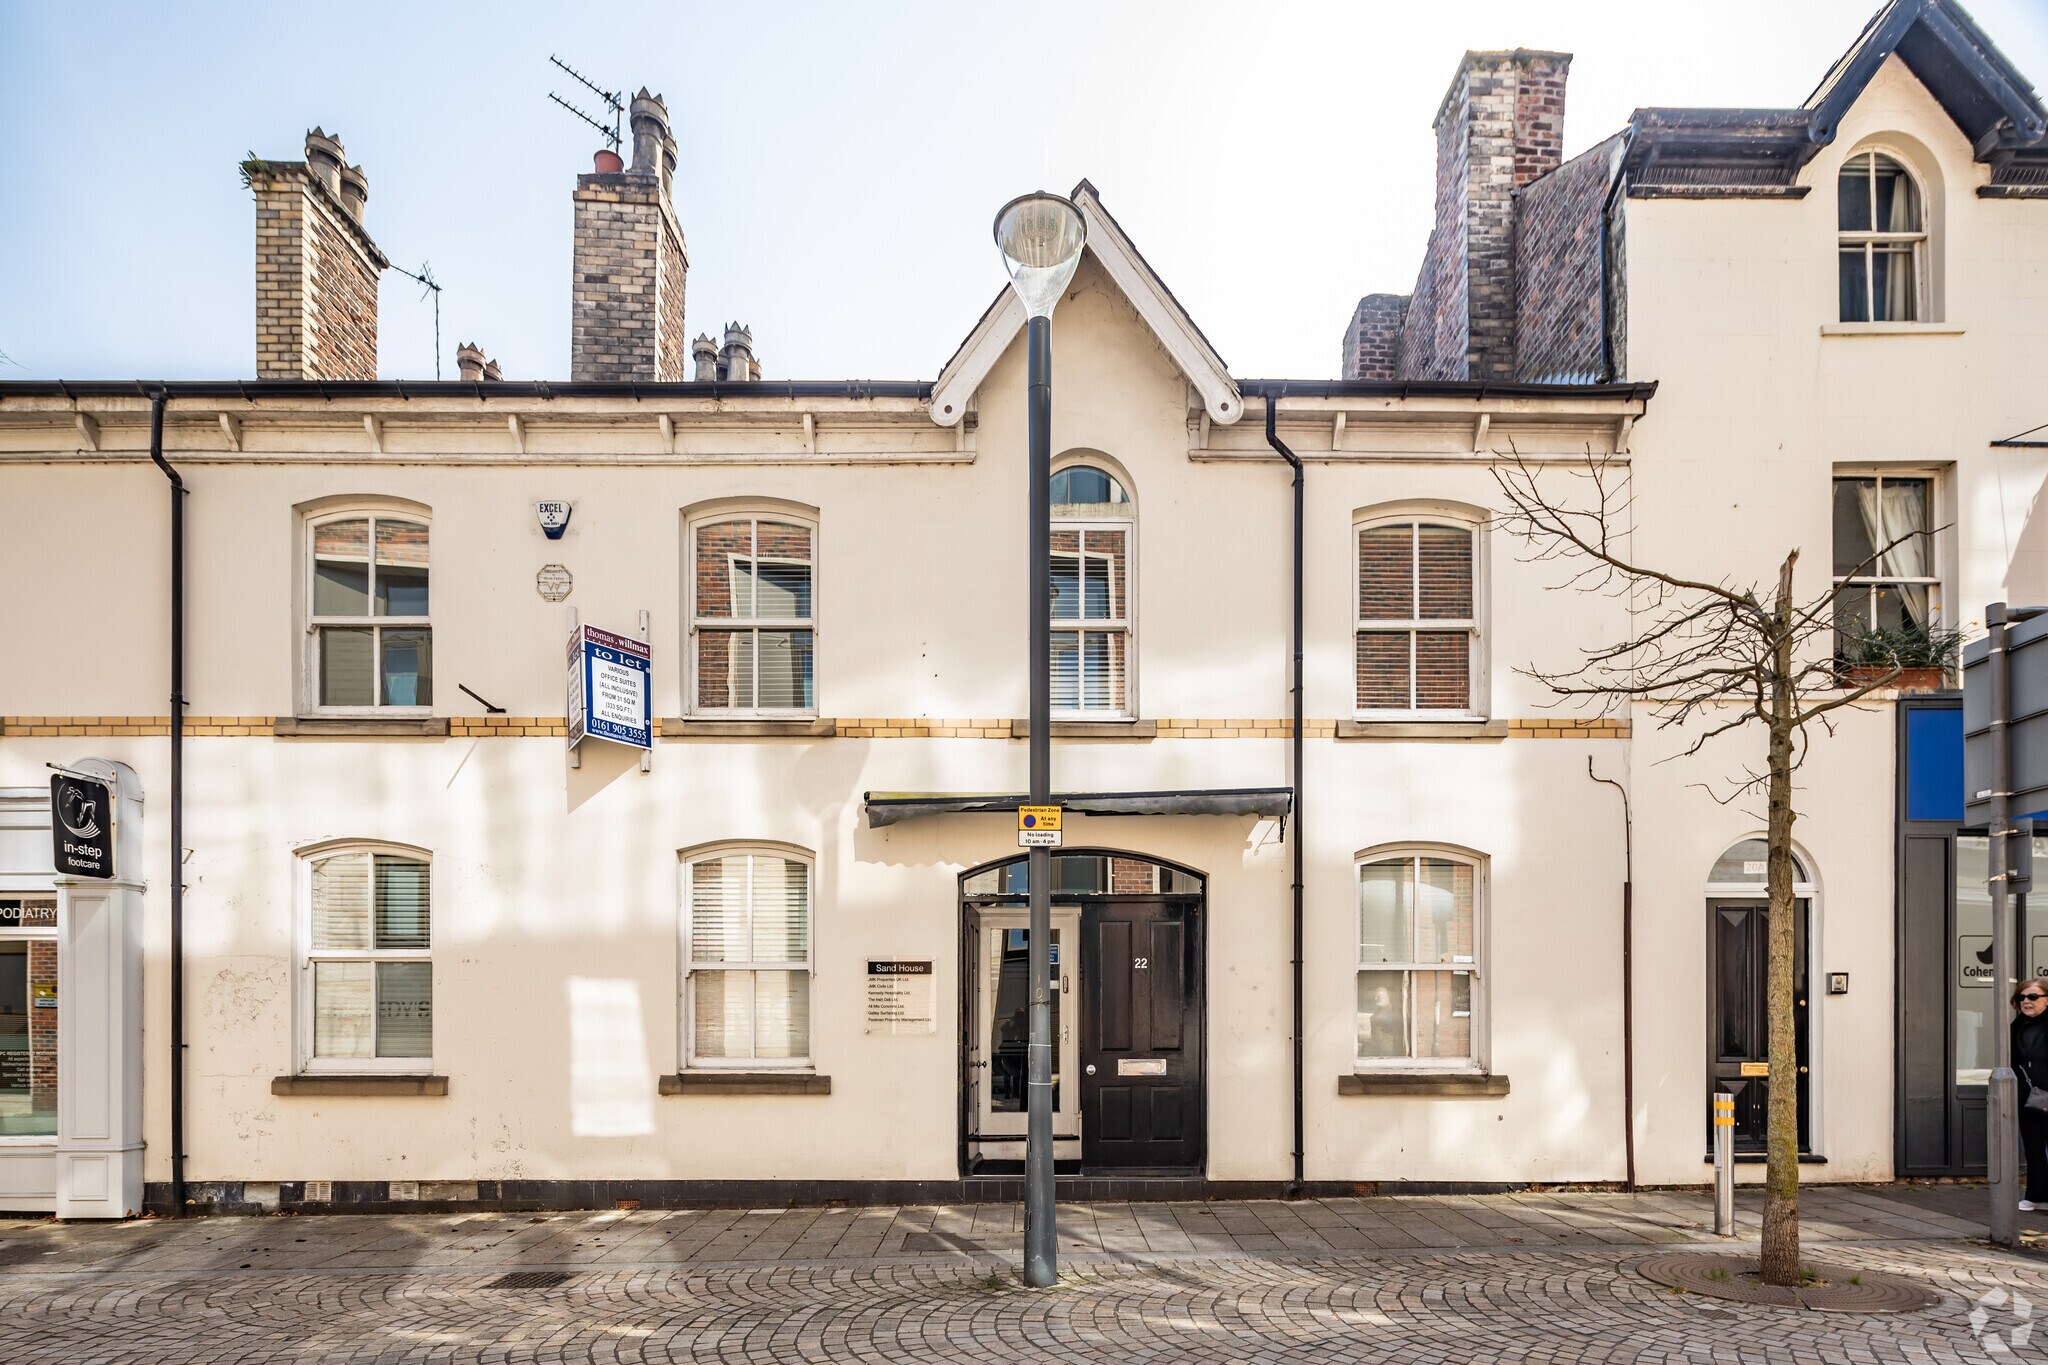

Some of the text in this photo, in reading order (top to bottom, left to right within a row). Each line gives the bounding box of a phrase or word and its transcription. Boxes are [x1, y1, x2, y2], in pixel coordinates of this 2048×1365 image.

[540, 503, 562, 512] EXCEL
[595, 647, 612, 660] to
[619, 654, 642, 669] let
[607, 665, 629, 676] VARIOUS
[601, 672, 636, 687] OFFICE SUITES
[600, 681, 638, 698] (ALL INCLUSIVE)
[602, 691, 616, 700] FROM
[601, 710, 637, 724] ALL ENQUIRIES
[591, 719, 610, 733] 0161
[613, 724, 627, 735] 905
[629, 727, 647, 740] 3555
[64, 840, 102, 859] in-step
[68, 857, 100, 870] footcare
[1746, 863, 1764, 872] 20A
[876, 964, 924, 972] Sand House
[1135, 958, 1147, 968] 22
